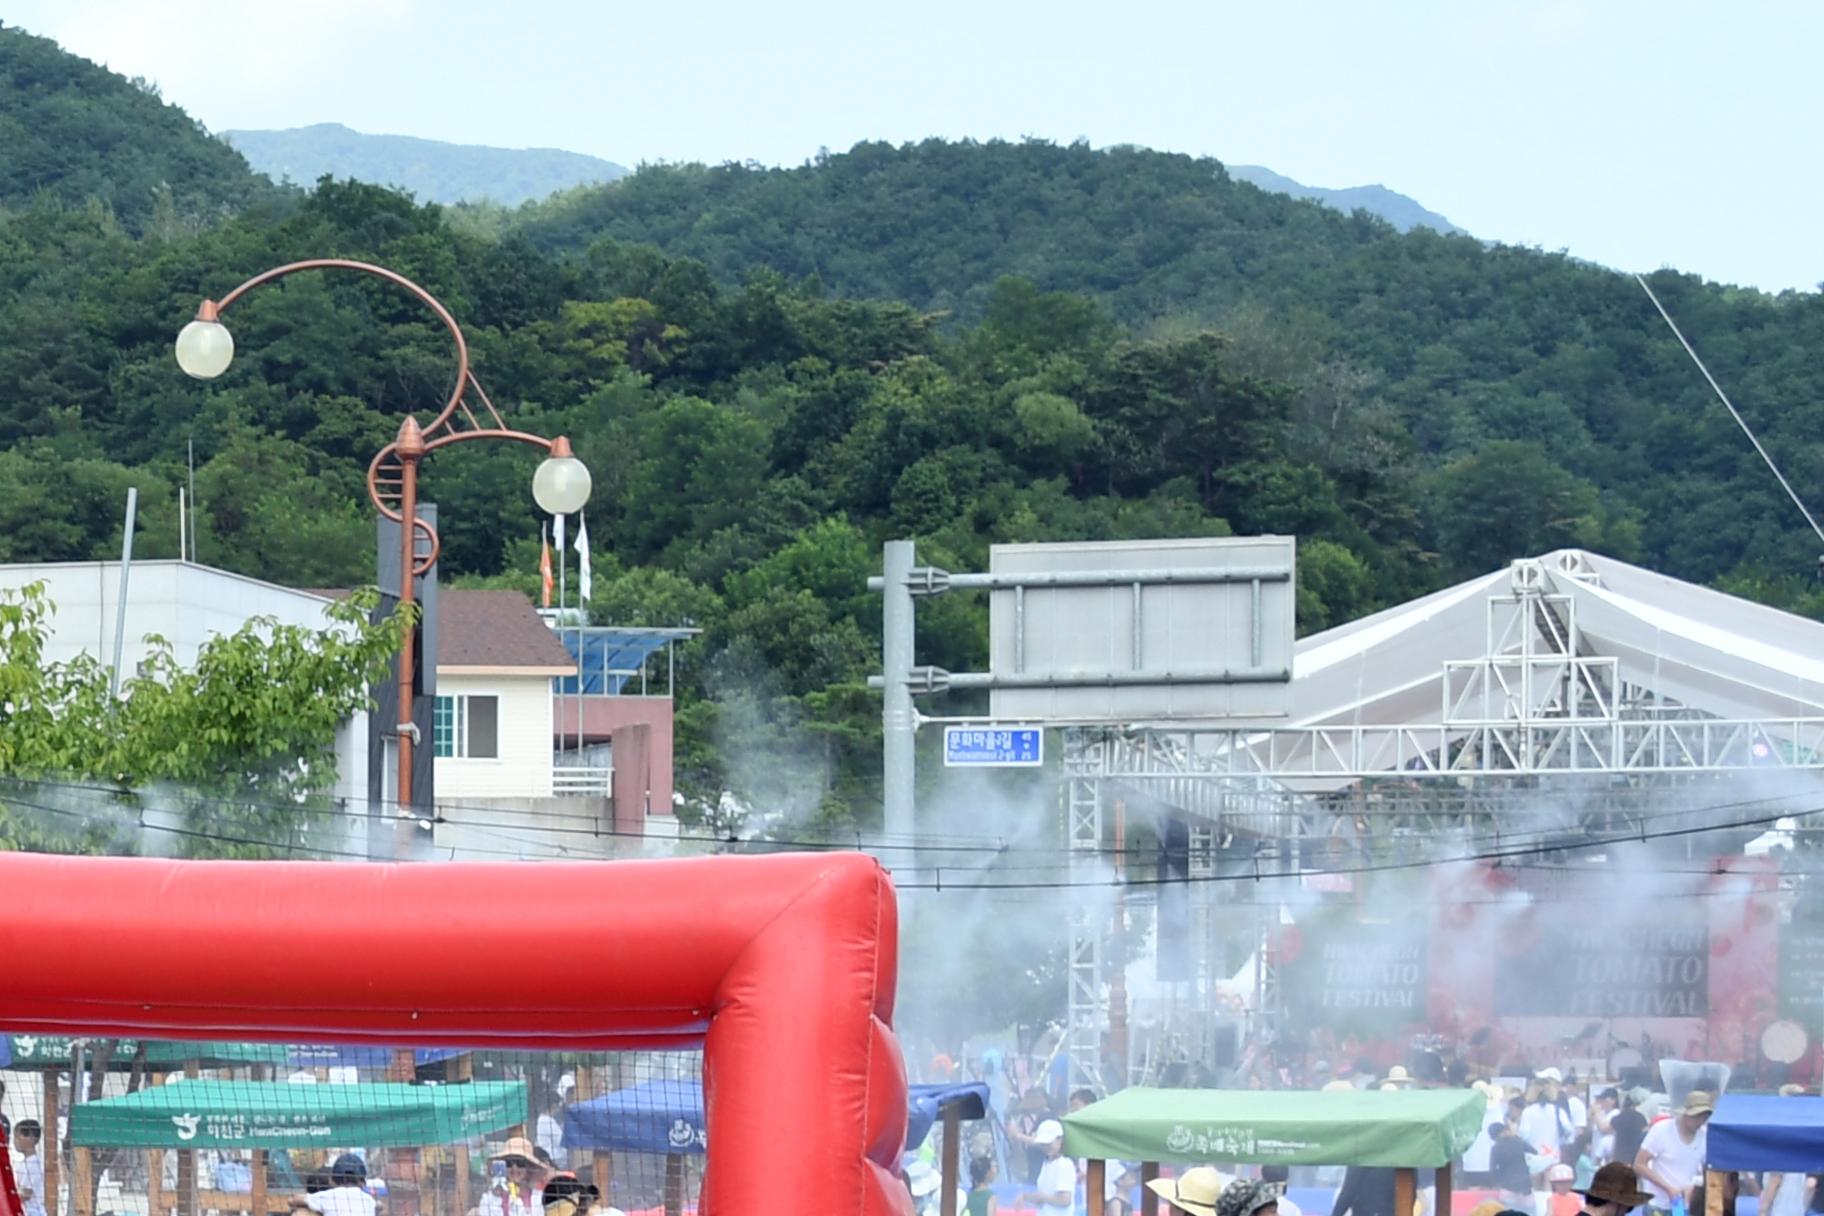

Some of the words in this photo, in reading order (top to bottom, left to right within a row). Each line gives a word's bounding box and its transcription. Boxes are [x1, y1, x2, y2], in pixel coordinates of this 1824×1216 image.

[1326, 963, 1419, 986] TOMATO
[1573, 955, 1702, 985] TOMATO
[1322, 990, 1415, 1008] FESTIVAL
[1570, 990, 1697, 1016] FESTIVAL
